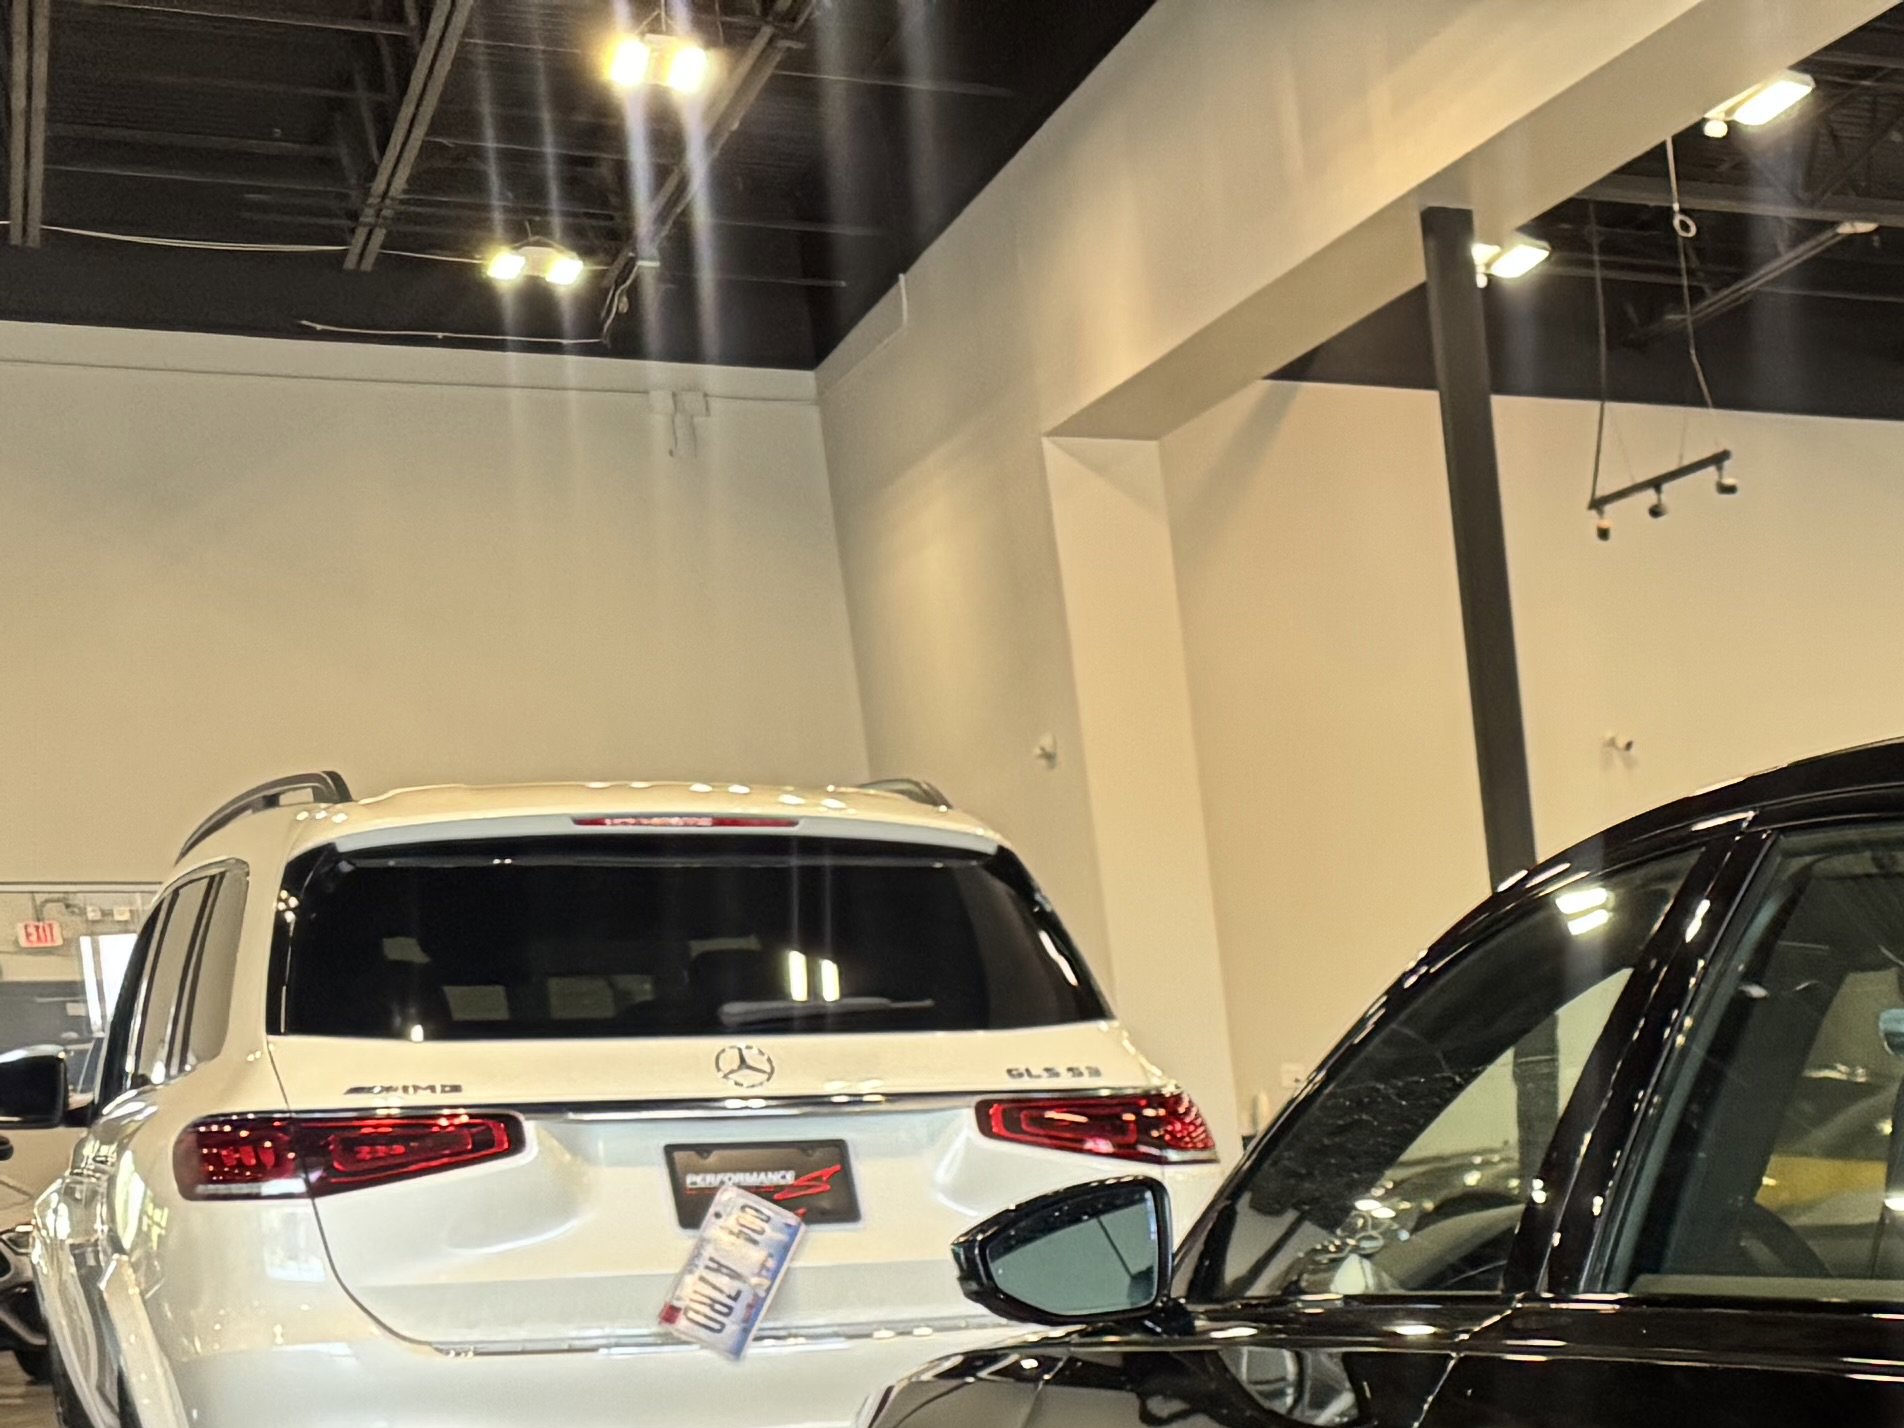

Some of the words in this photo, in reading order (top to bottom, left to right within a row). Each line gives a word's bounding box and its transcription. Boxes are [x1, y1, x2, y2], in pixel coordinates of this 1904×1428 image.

[24, 922, 55, 943] EXIT
[1006, 1067, 1060, 1079] GLS
[686, 1170, 796, 1188] PERFORMANCE
